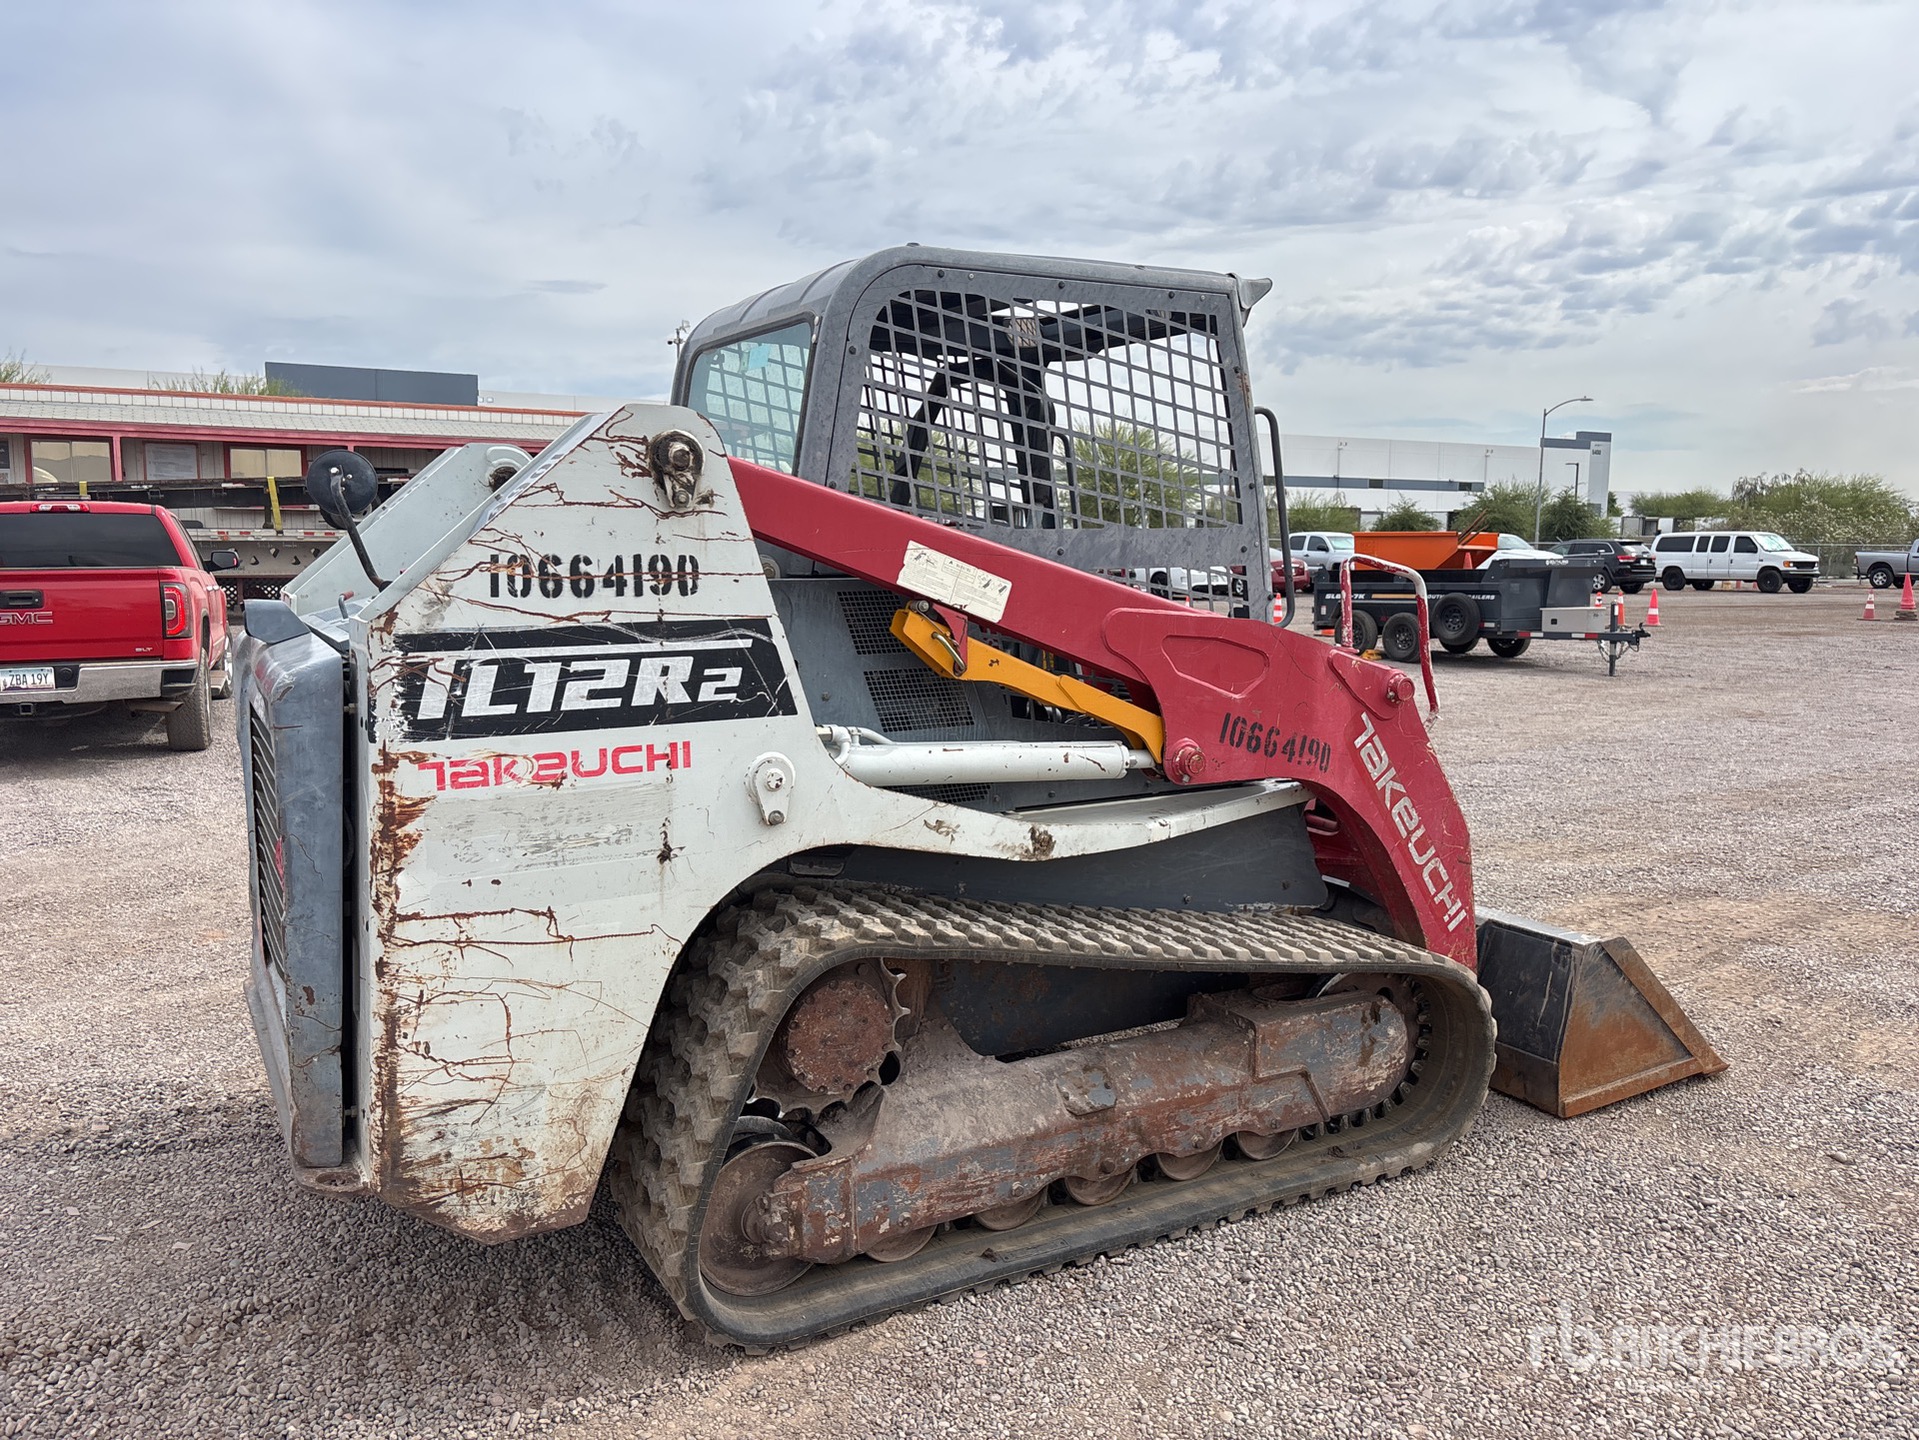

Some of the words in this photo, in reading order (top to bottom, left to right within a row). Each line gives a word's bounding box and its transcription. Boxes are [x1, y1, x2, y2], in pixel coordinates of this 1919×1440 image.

[489, 553, 699, 598] 10664190
[9, 674, 28, 686] ZBA
[31, 673, 49, 685] 19Y
[1219, 712, 1331, 773] 10664190
